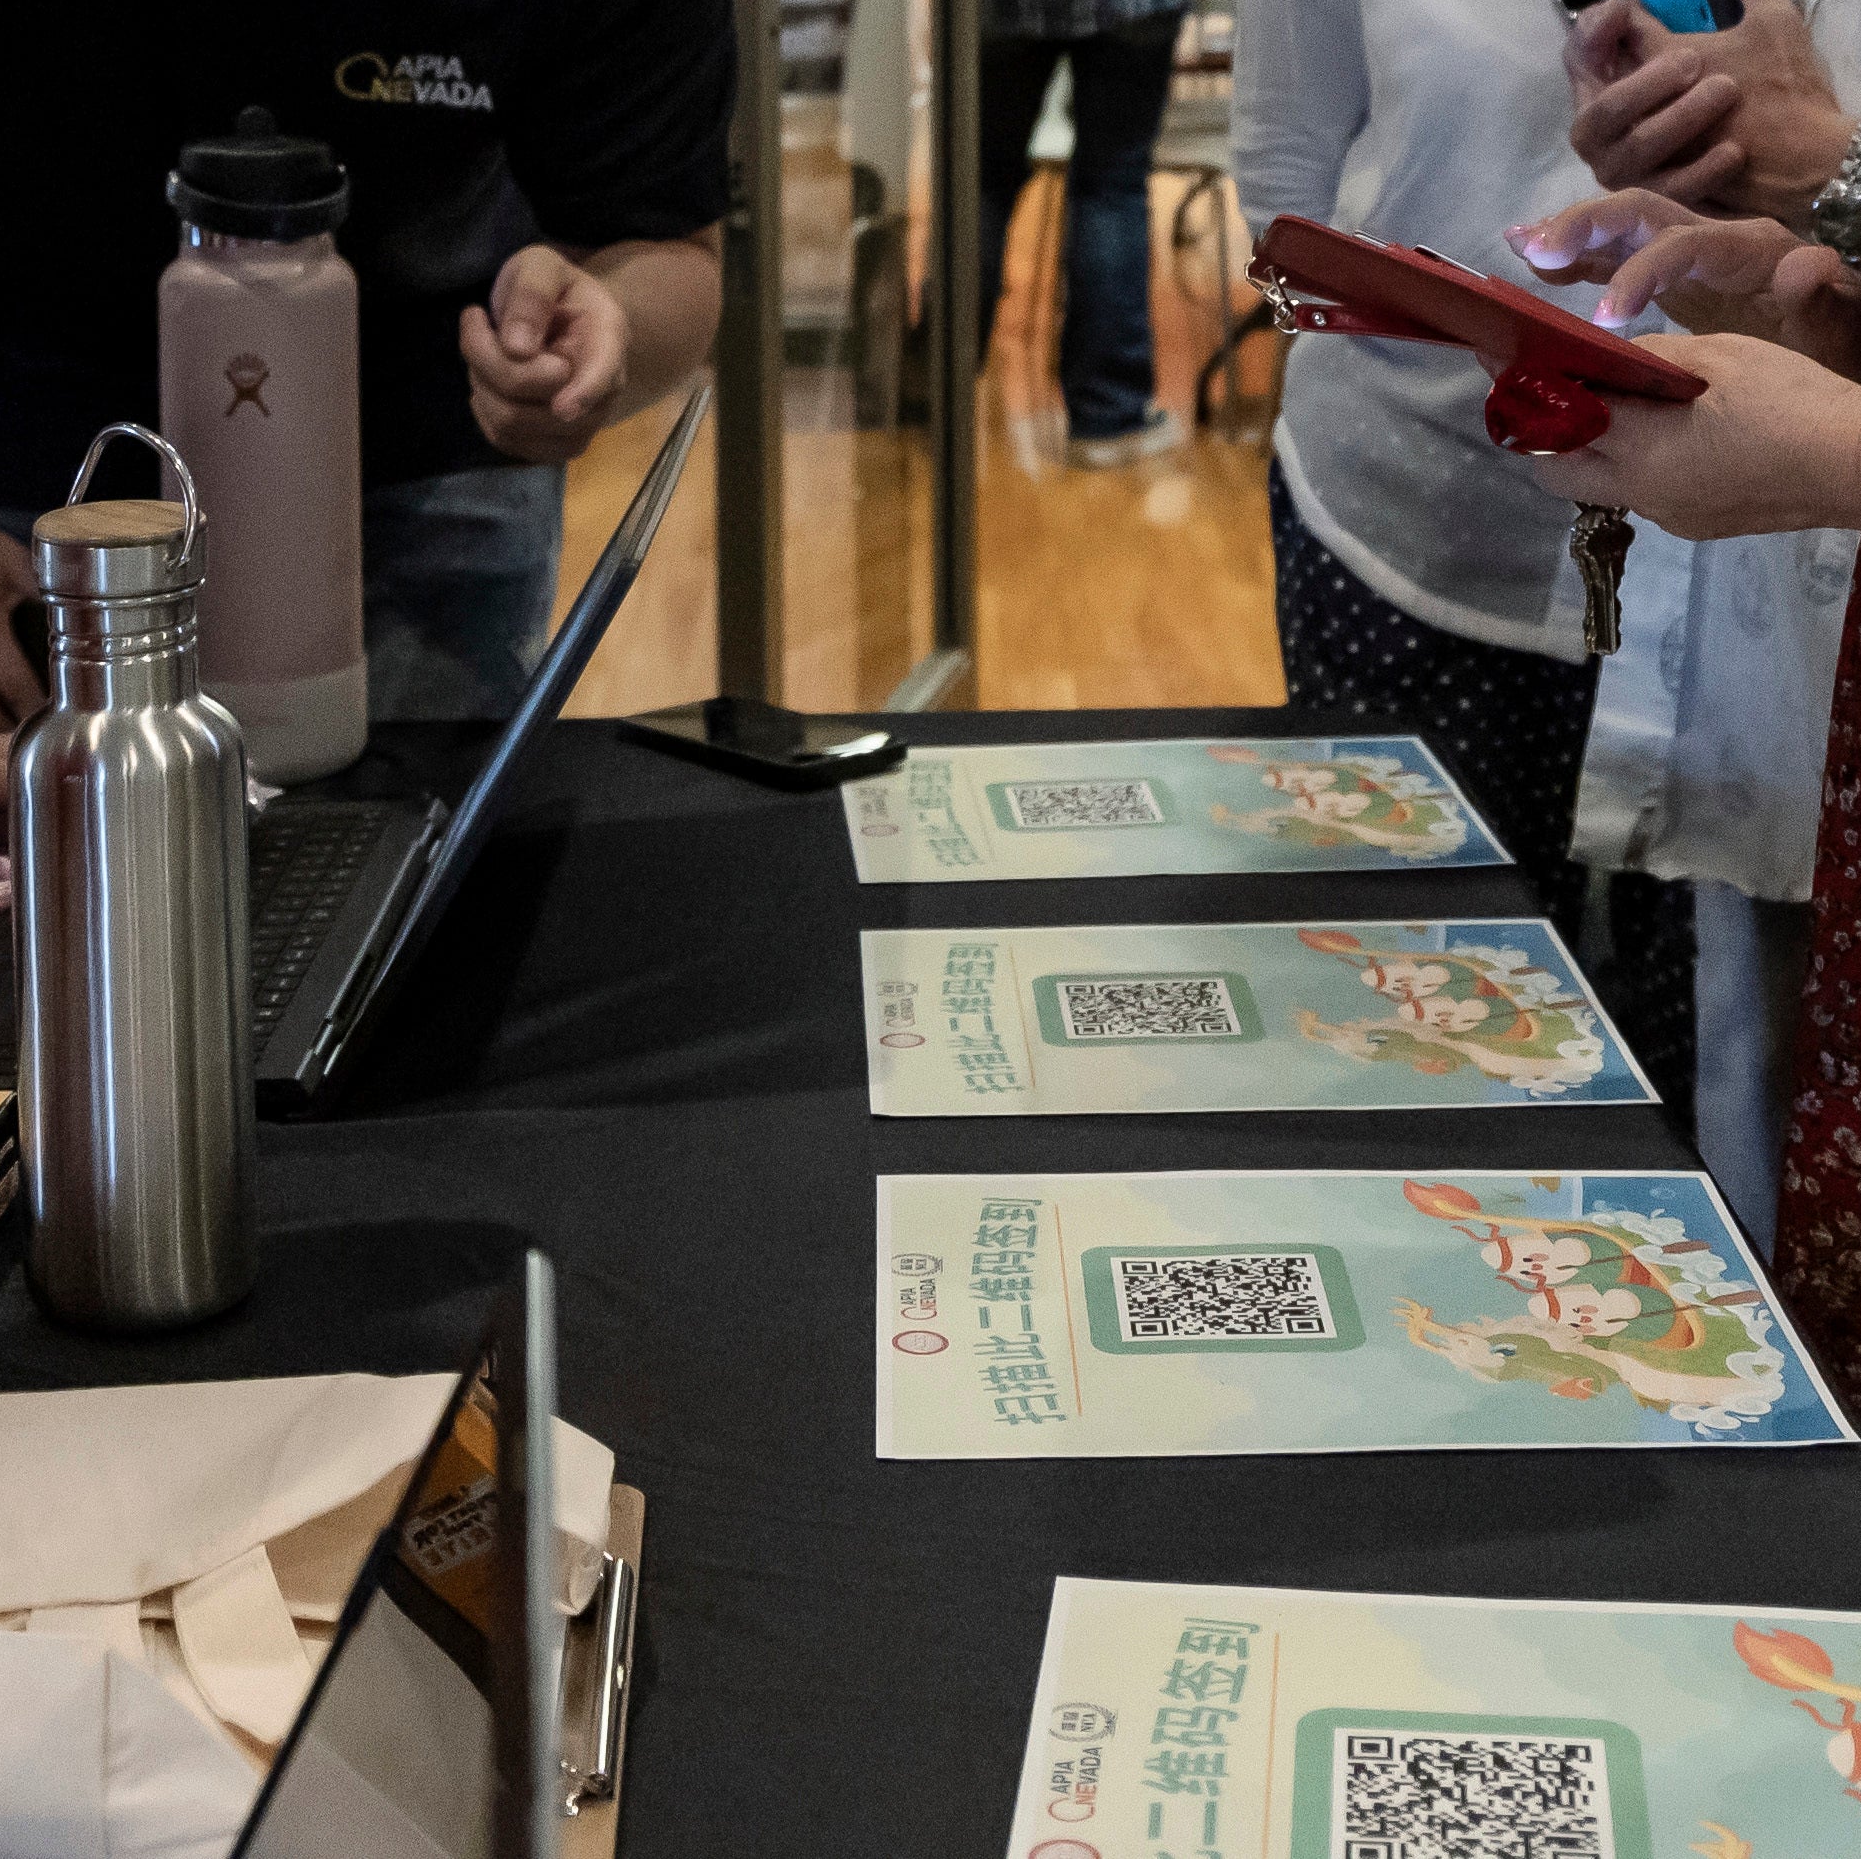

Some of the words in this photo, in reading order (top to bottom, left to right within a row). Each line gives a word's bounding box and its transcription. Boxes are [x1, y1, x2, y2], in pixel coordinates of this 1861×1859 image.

[393, 54, 464, 80] APIA
[371, 76, 494, 112] NEVADA
[899, 1286, 918, 1307] APIA
[969, 1197, 1068, 1426] 扫描此二维码签到
[1140, 1616, 1261, 1859] 二维码签到
[1051, 1758, 1076, 1795] APIA
[1075, 1744, 1104, 1807] NEVADA
